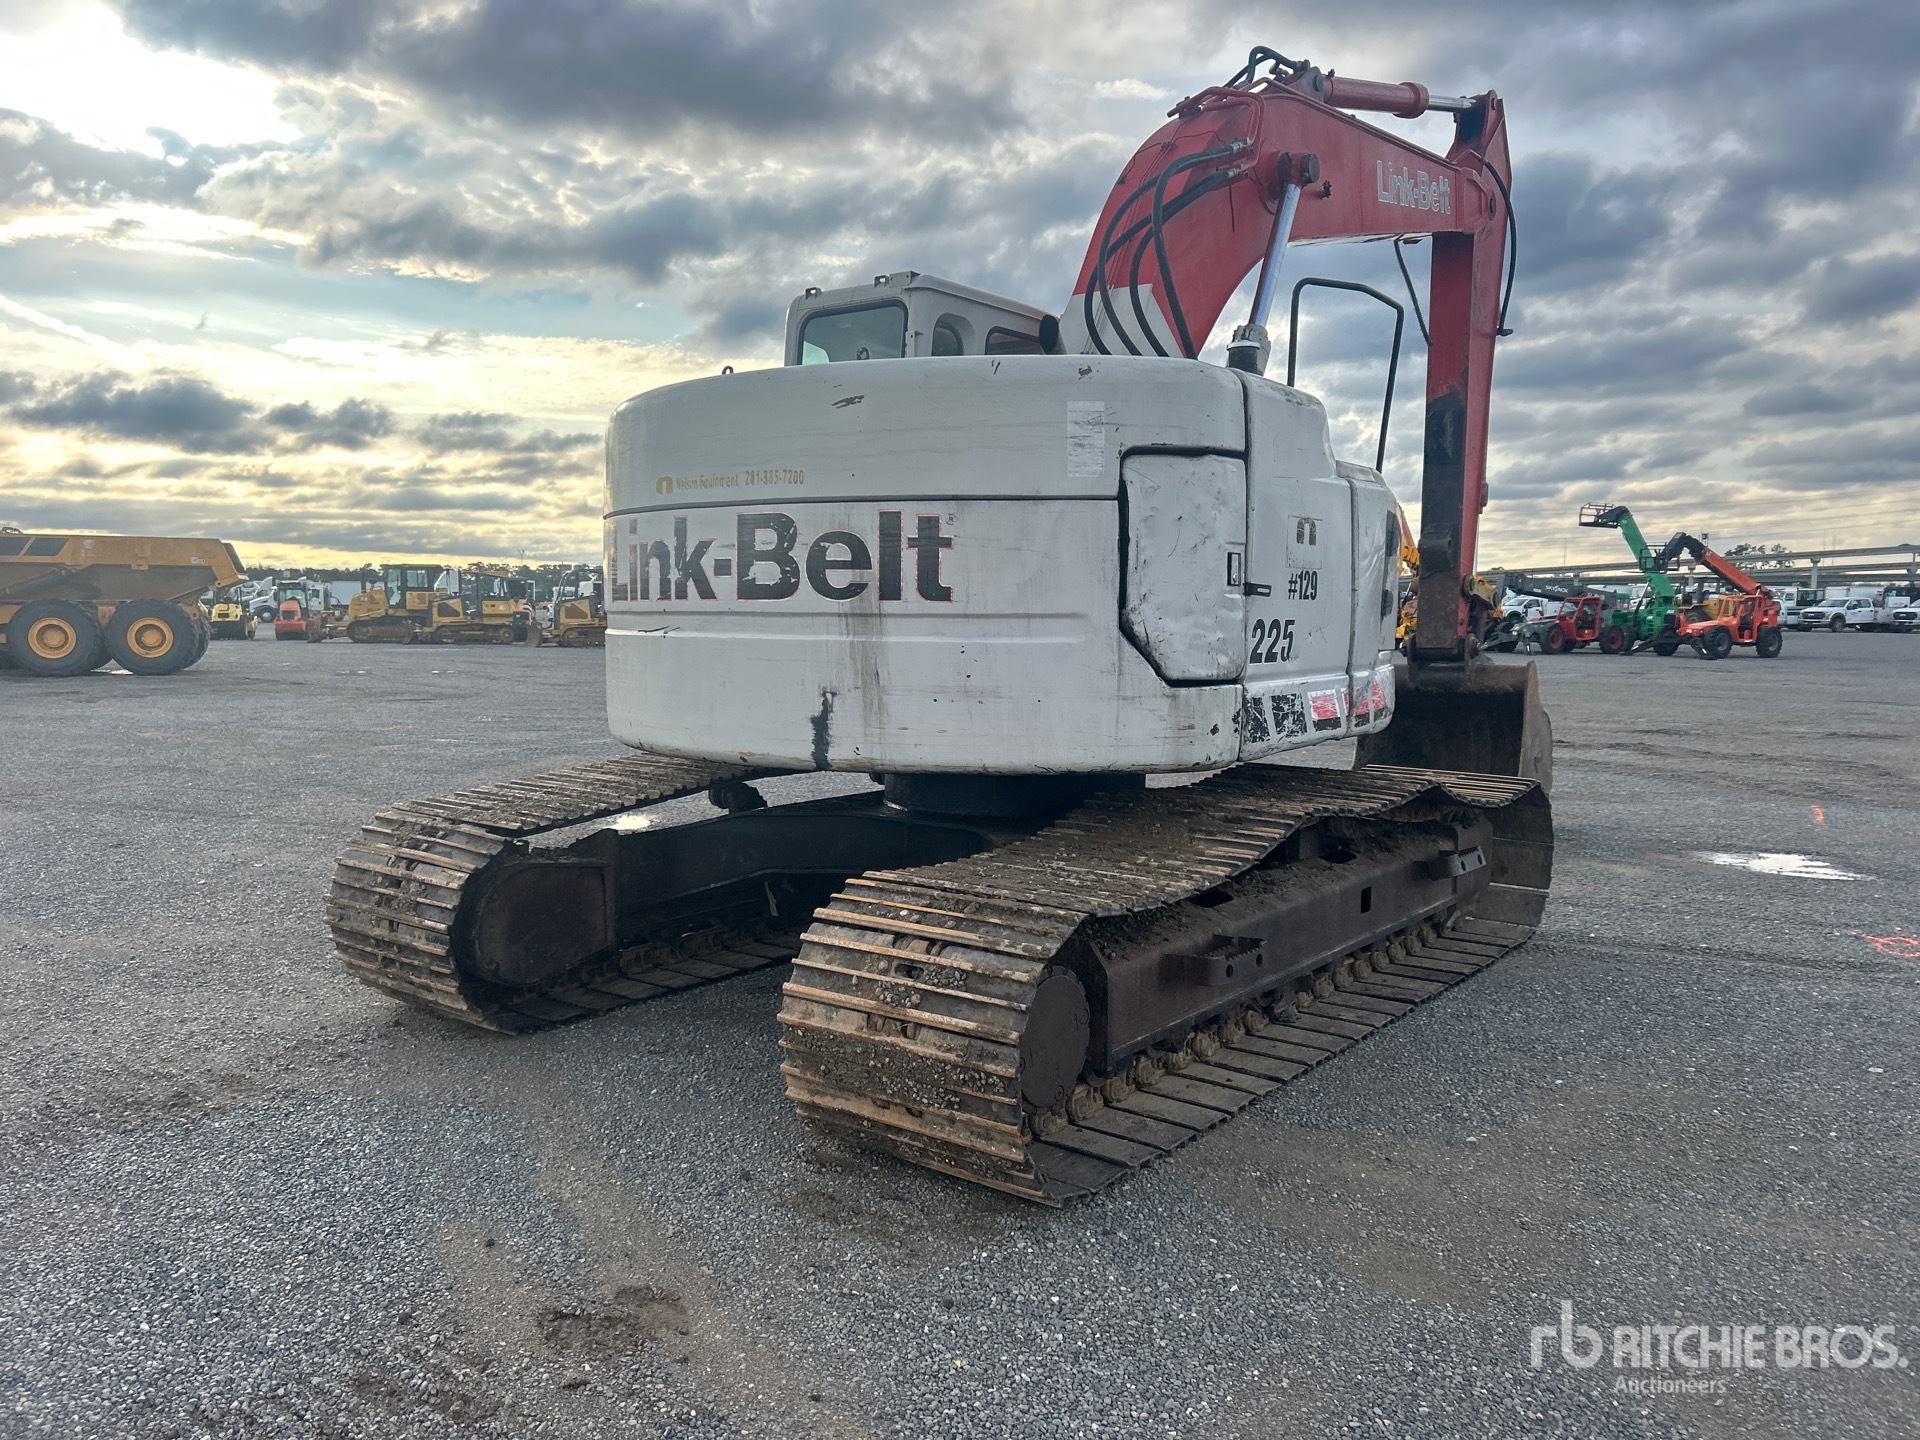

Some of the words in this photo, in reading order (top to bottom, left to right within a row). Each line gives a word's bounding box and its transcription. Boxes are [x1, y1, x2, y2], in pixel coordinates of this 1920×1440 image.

[1377, 160, 1451, 215] Link-Belt
[611, 509, 954, 602] Link-Belt
[1288, 570, 1318, 601] #129
[1250, 618, 1296, 664] 225
